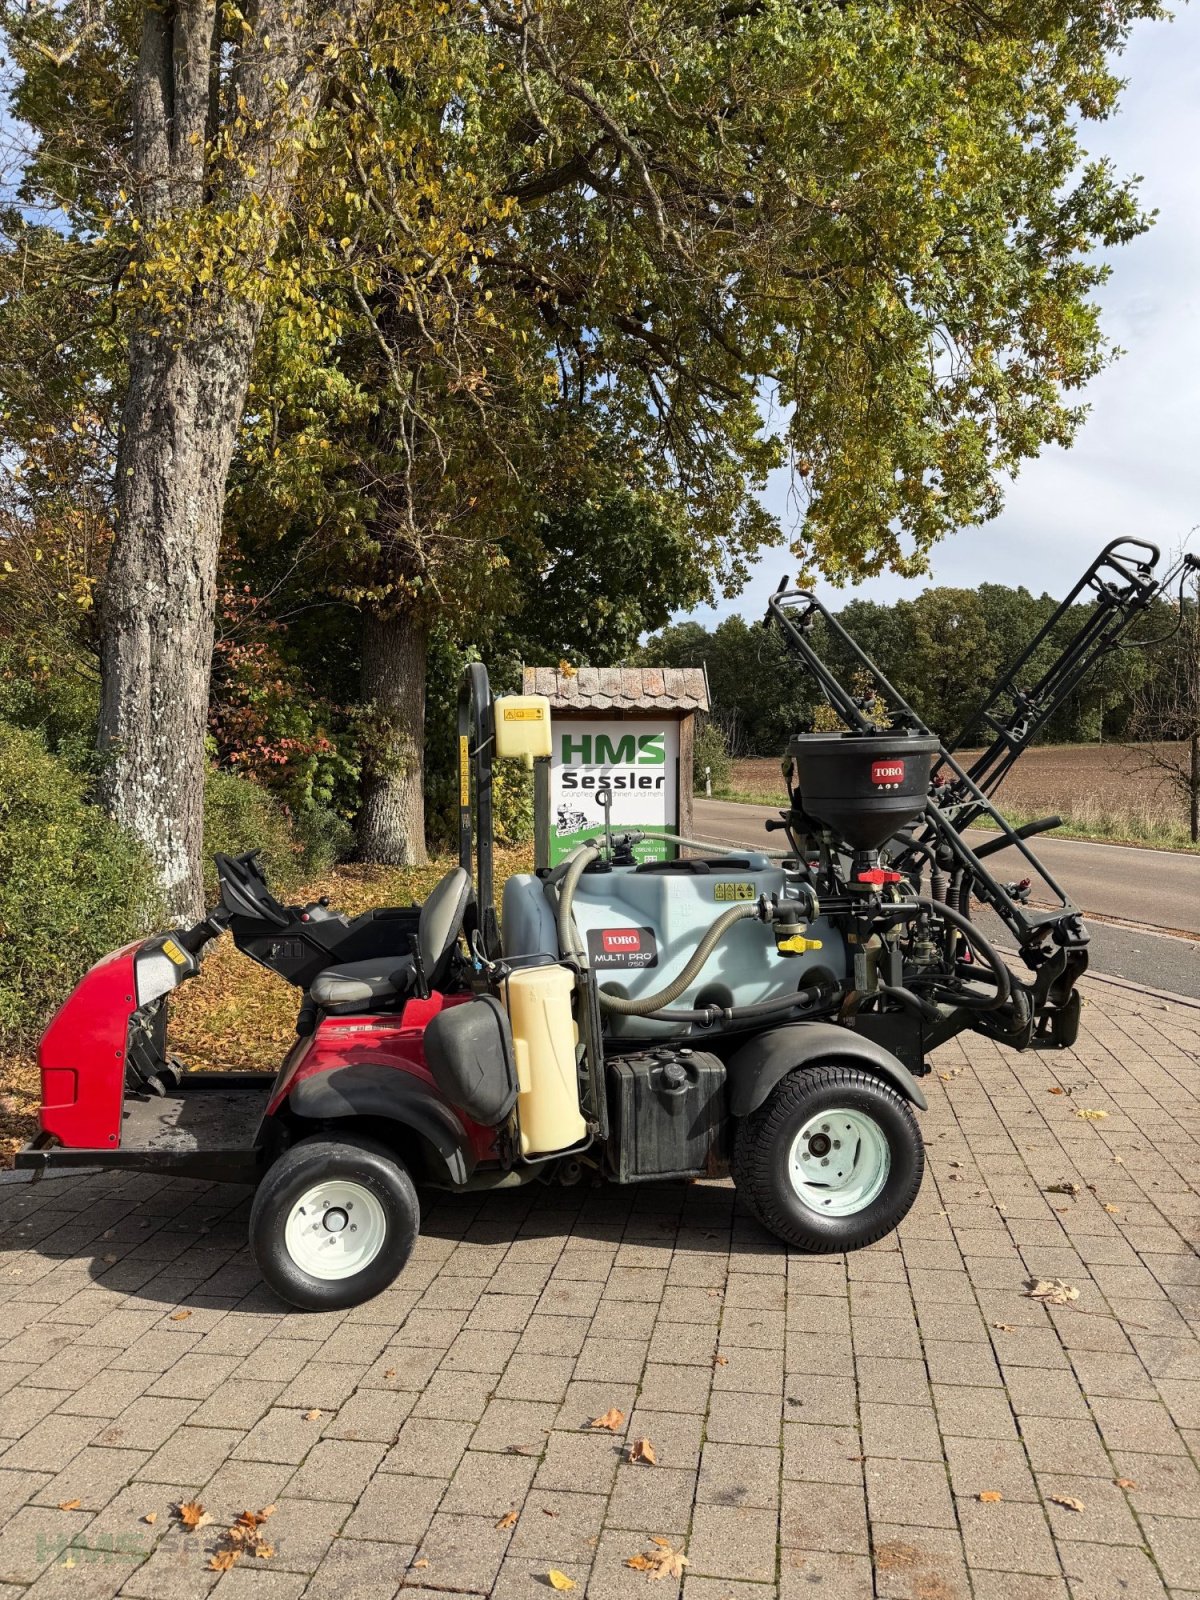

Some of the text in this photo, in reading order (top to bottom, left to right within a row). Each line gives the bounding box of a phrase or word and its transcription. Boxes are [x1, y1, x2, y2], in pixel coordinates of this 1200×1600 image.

[562, 734, 666, 765] HMS
[874, 767, 902, 777] TORO
[562, 772, 666, 789] Sessler
[605, 935, 639, 945] TORO
[595, 953, 652, 962] MULTI PRO
